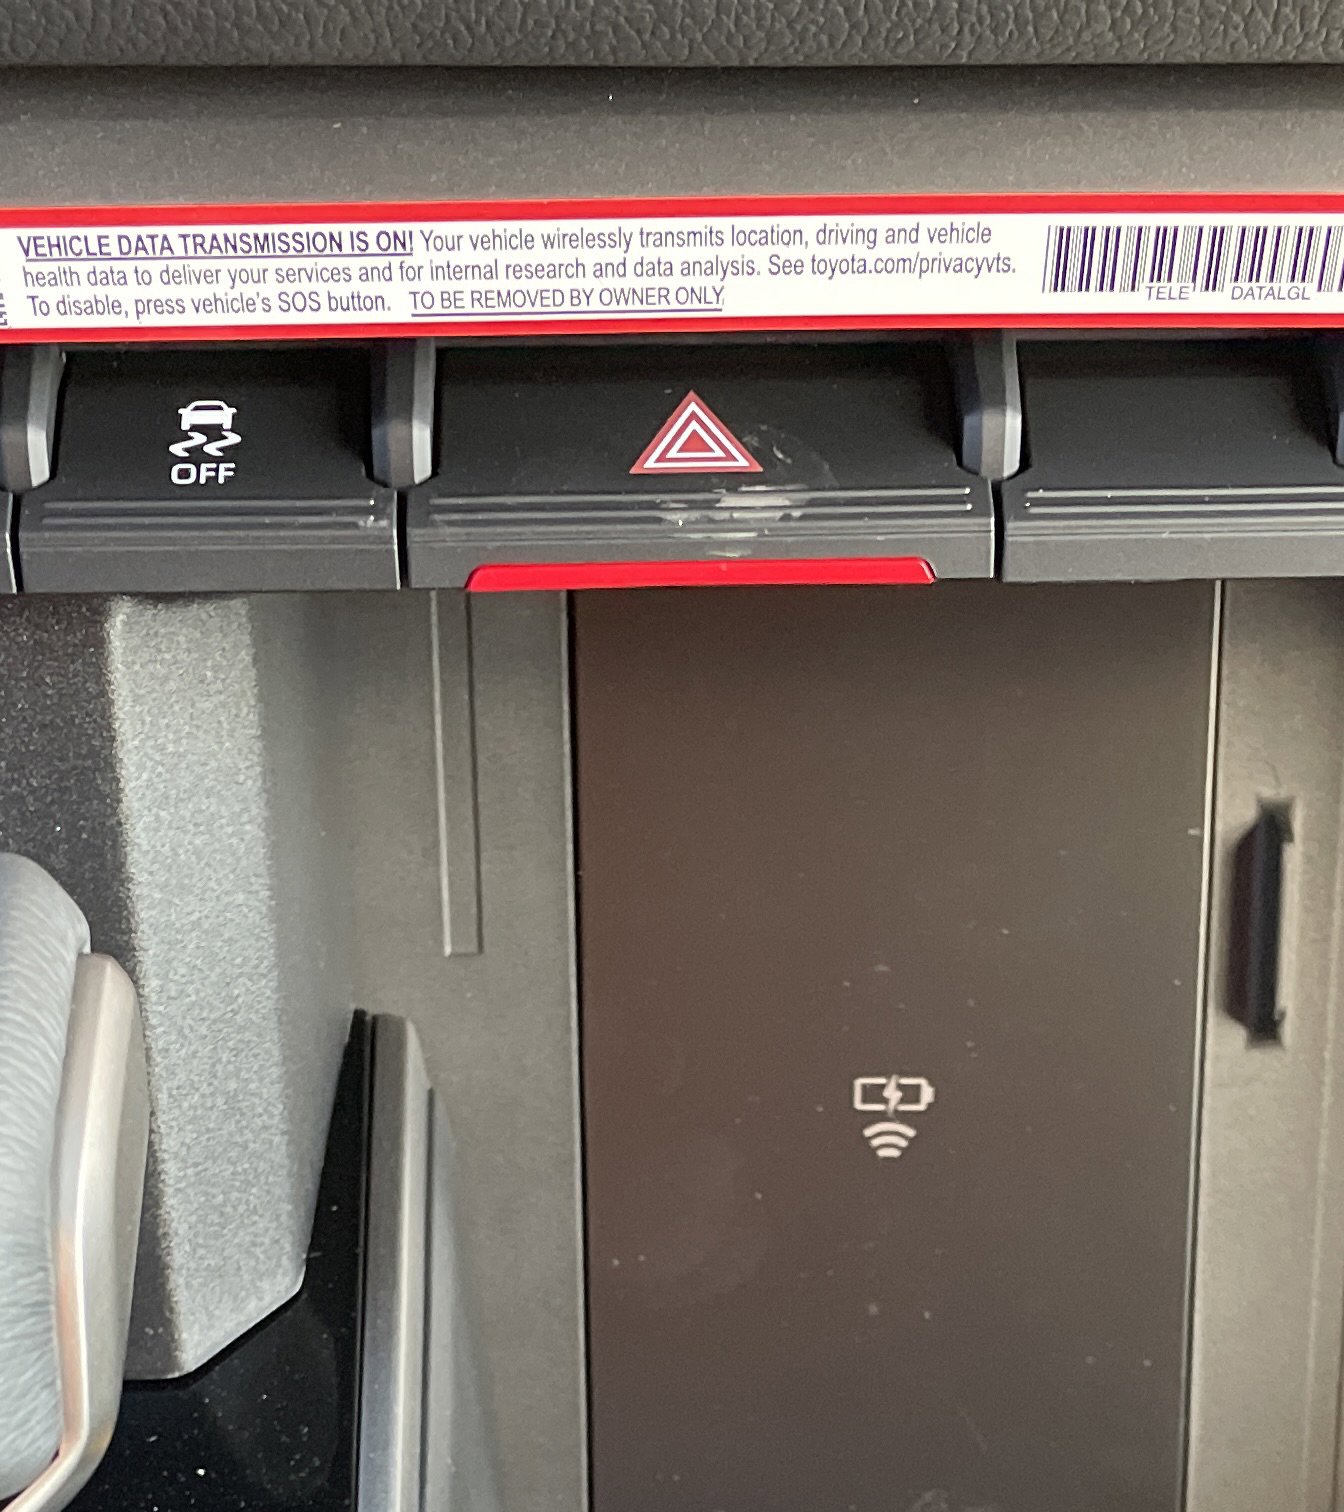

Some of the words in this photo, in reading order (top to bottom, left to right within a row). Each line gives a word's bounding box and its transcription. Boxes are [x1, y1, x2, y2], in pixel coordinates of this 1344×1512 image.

[17, 235, 112, 258] VEHICLE
[117, 234, 175, 257] DATA
[178, 231, 343, 256] TRANSMISSION
[349, 230, 369, 252] IS
[376, 230, 414, 252] ON!
[419, 229, 464, 252] Your
[469, 228, 535, 251] vehicle
[541, 226, 634, 254] wirelessly
[639, 225, 725, 248] transmits
[731, 224, 809, 249] location,
[815, 223, 878, 250] driving
[885, 222, 920, 245] and
[927, 221, 992, 244] vehicle
[22, 265, 81, 288] health
[87, 265, 128, 287] data
[134, 265, 153, 286] to
[159, 264, 222, 286] deliver
[227, 268, 269, 290] your
[275, 262, 353, 285] services
[358, 261, 393, 283] and
[399, 260, 424, 282] for
[429, 259, 499, 281] internal
[505, 257, 586, 280] research
[592, 256, 627, 279] and
[633, 256, 674, 278] data
[680, 254, 761, 282] analysis.
[768, 254, 805, 276] See
[811, 251, 1017, 281] toyota.com/privacyvts.
[26, 295, 50, 317] To
[56, 294, 129, 319] disable,
[134, 297, 186, 321] press
[190, 291, 273, 315] vehicle's
[278, 291, 322, 313] SOS
[327, 290, 392, 312] button.
[408, 290, 435, 310] TO
[440, 290, 465, 309] BE
[470, 288, 565, 309] REMOVED
[570, 288, 595, 307] BY
[599, 287, 671, 307] OWNER
[1145, 285, 1191, 301] TELE
[1230, 285, 1312, 301] DATALGL
[170, 462, 236, 485] OFF
